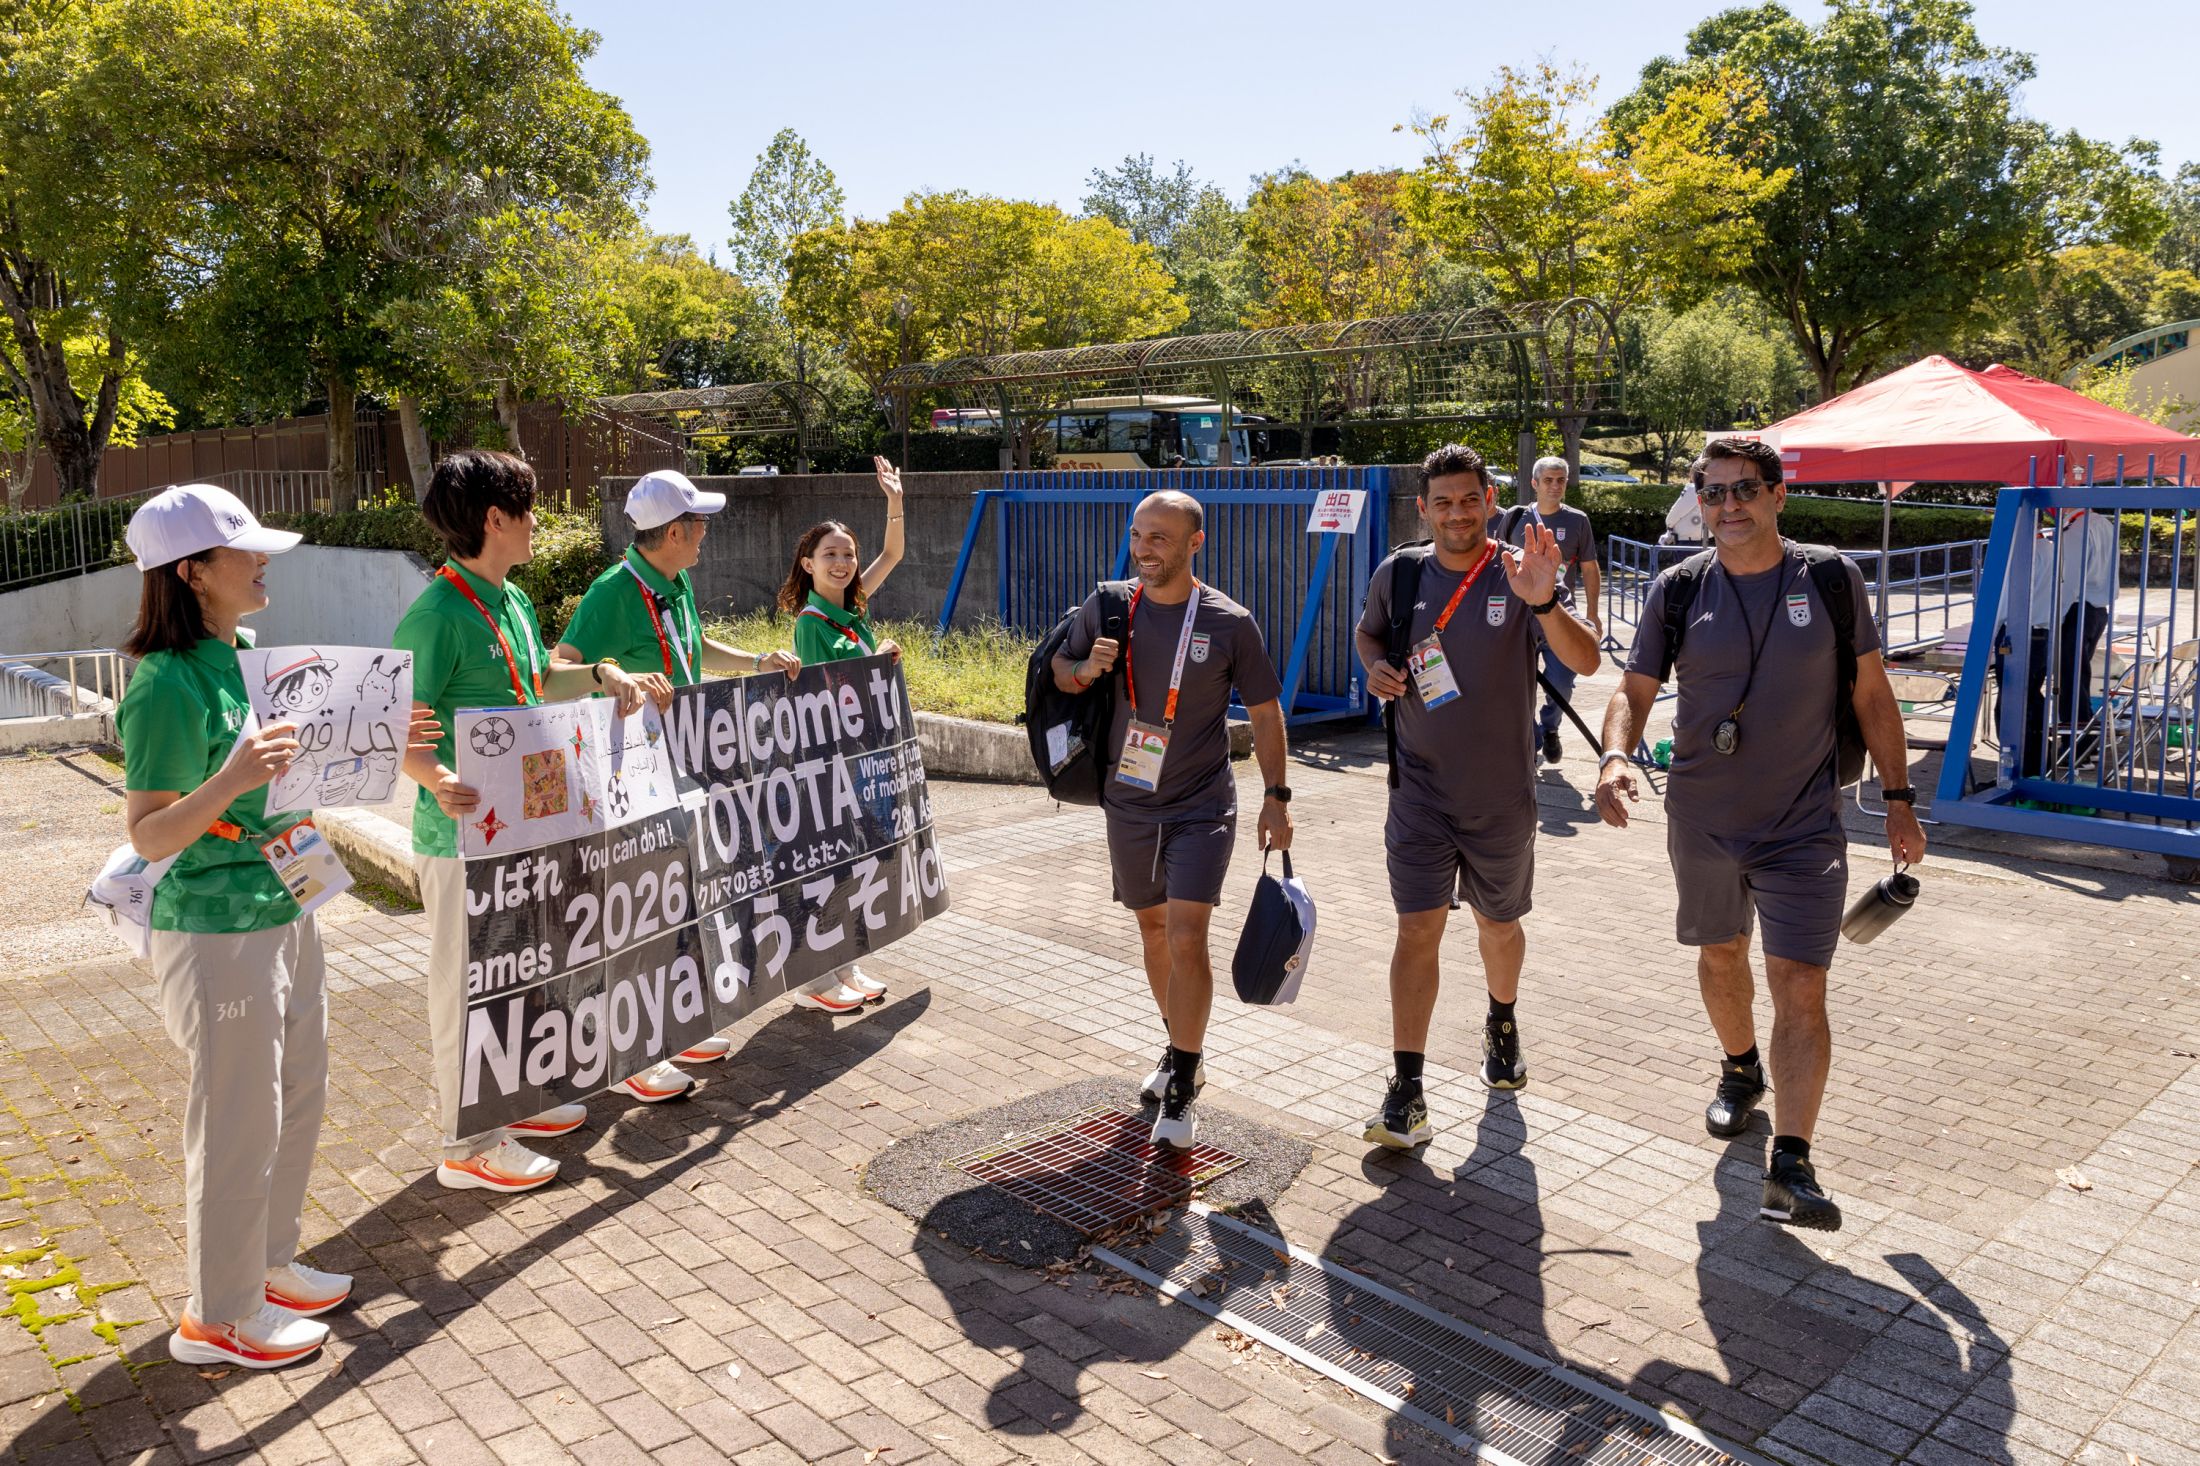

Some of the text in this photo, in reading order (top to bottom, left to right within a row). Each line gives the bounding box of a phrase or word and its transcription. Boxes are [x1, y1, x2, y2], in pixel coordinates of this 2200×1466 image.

[1325, 493, 1351, 506] 出口
[488, 644, 504, 660] 36
[663, 684, 864, 778] Welcome
[859, 755, 897, 778] Where
[679, 752, 863, 872] TOYOTA
[863, 779, 876, 802] of
[466, 855, 564, 917] んばれ
[579, 844, 609, 874] You
[612, 837, 638, 864] can
[640, 830, 656, 852] do
[698, 838, 851, 911] クルマのまち・とよたへ
[900, 828, 948, 917] Aich
[468, 860, 688, 998] ames 2026
[714, 855, 889, 1004] ようこそ
[461, 955, 705, 1108] Nagoya
